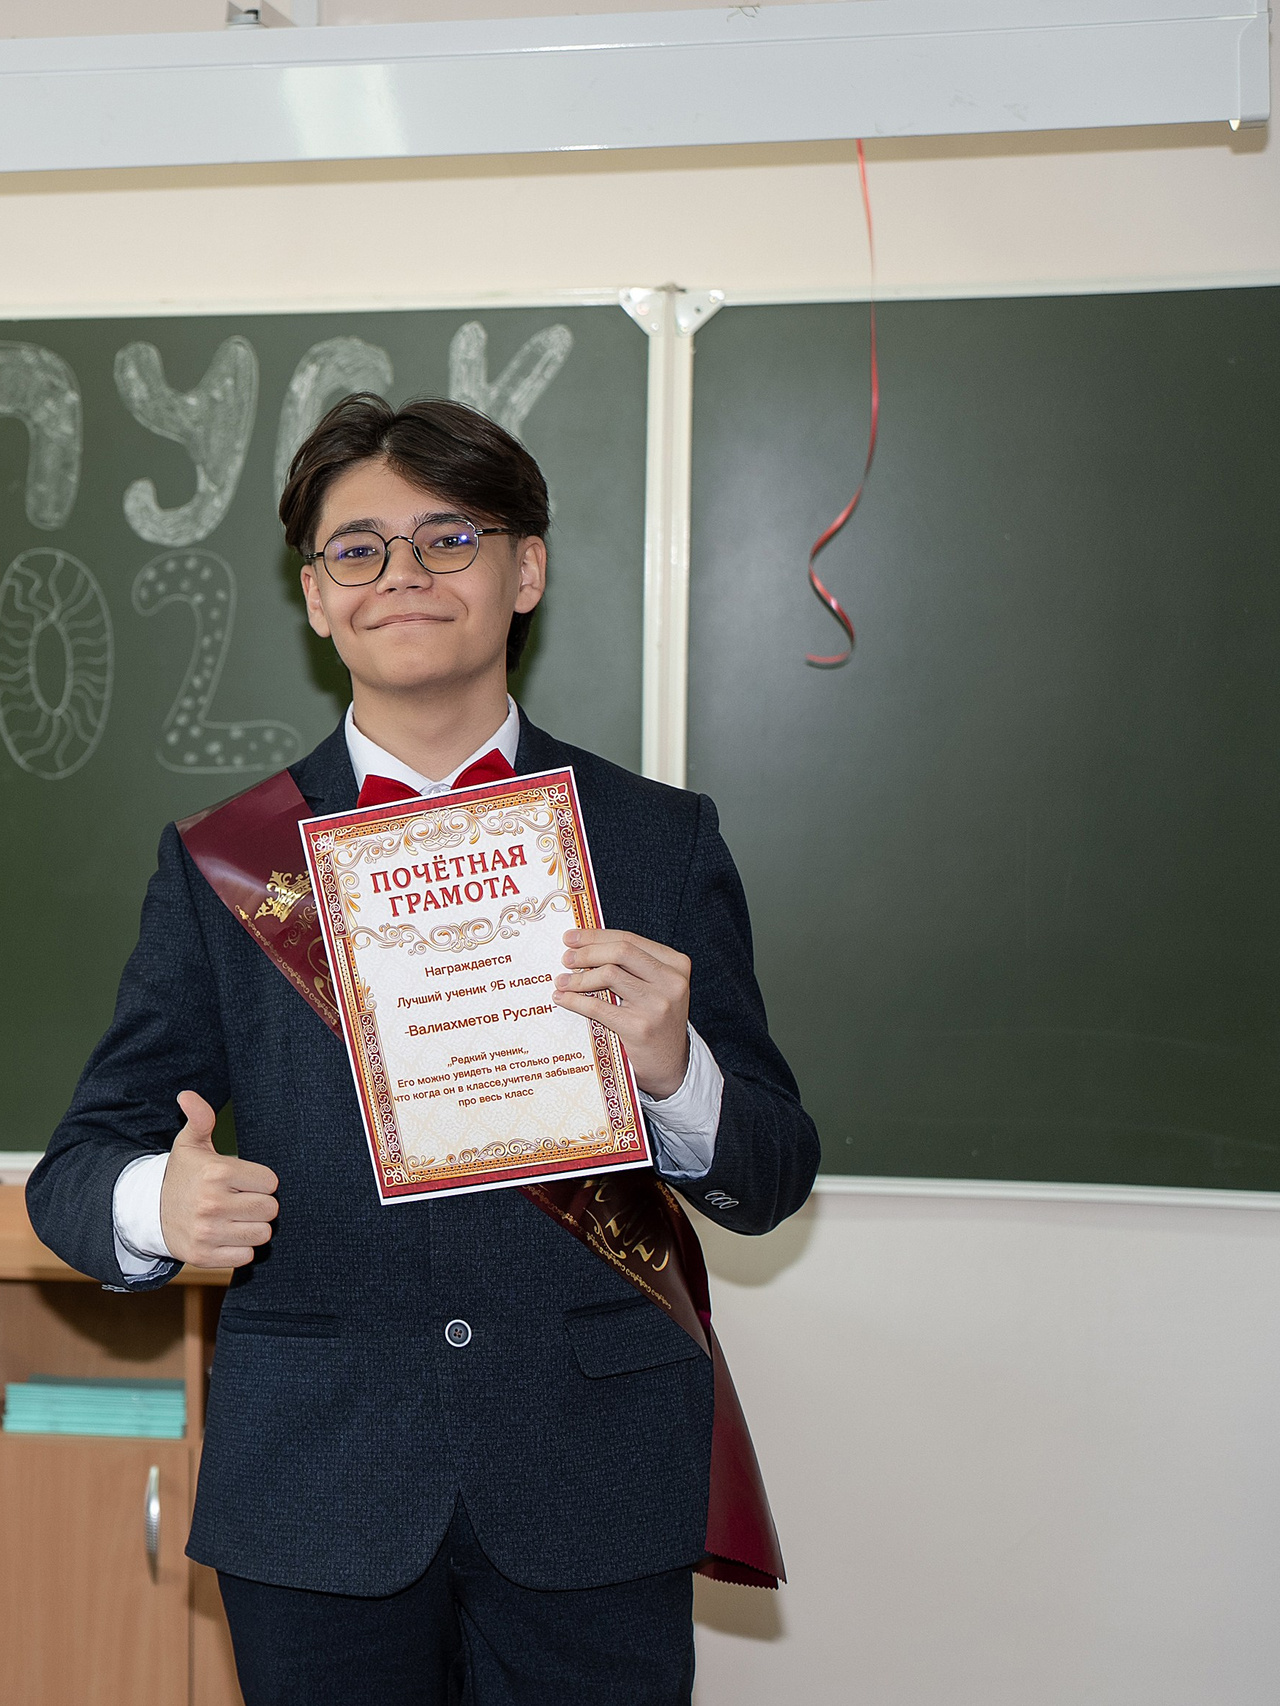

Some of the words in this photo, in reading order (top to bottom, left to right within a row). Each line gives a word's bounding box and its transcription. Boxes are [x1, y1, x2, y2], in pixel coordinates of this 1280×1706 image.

[370, 844, 528, 894] ПОЧЁТНАЯ
[388, 874, 521, 918] ГРАМОТА
[424, 953, 513, 978] Награждается
[396, 990, 443, 1010] Лучший
[444, 984, 488, 1002] ученик
[489, 979, 507, 993] 9Б
[509, 973, 553, 989] класса
[404, 1012, 500, 1037] -Валиахметов
[394, 1094, 411, 1103] что
[412, 1089, 441, 1100] когда
[443, 1086, 456, 1096] он
[457, 1085, 464, 1093] в
[466, 1072, 543, 1091] классе,учителя
[544, 1063, 595, 1079] забывают
[397, 1079, 415, 1089] Его
[417, 1073, 451, 1085] можно
[452, 1065, 493, 1081] увидеть
[494, 1063, 507, 1073] на
[509, 1056, 550, 1070] столько
[552, 1051, 586, 1065] редко,
[458, 1096, 477, 1108] про
[478, 1094, 503, 1104] весь
[504, 1087, 535, 1100] класс
